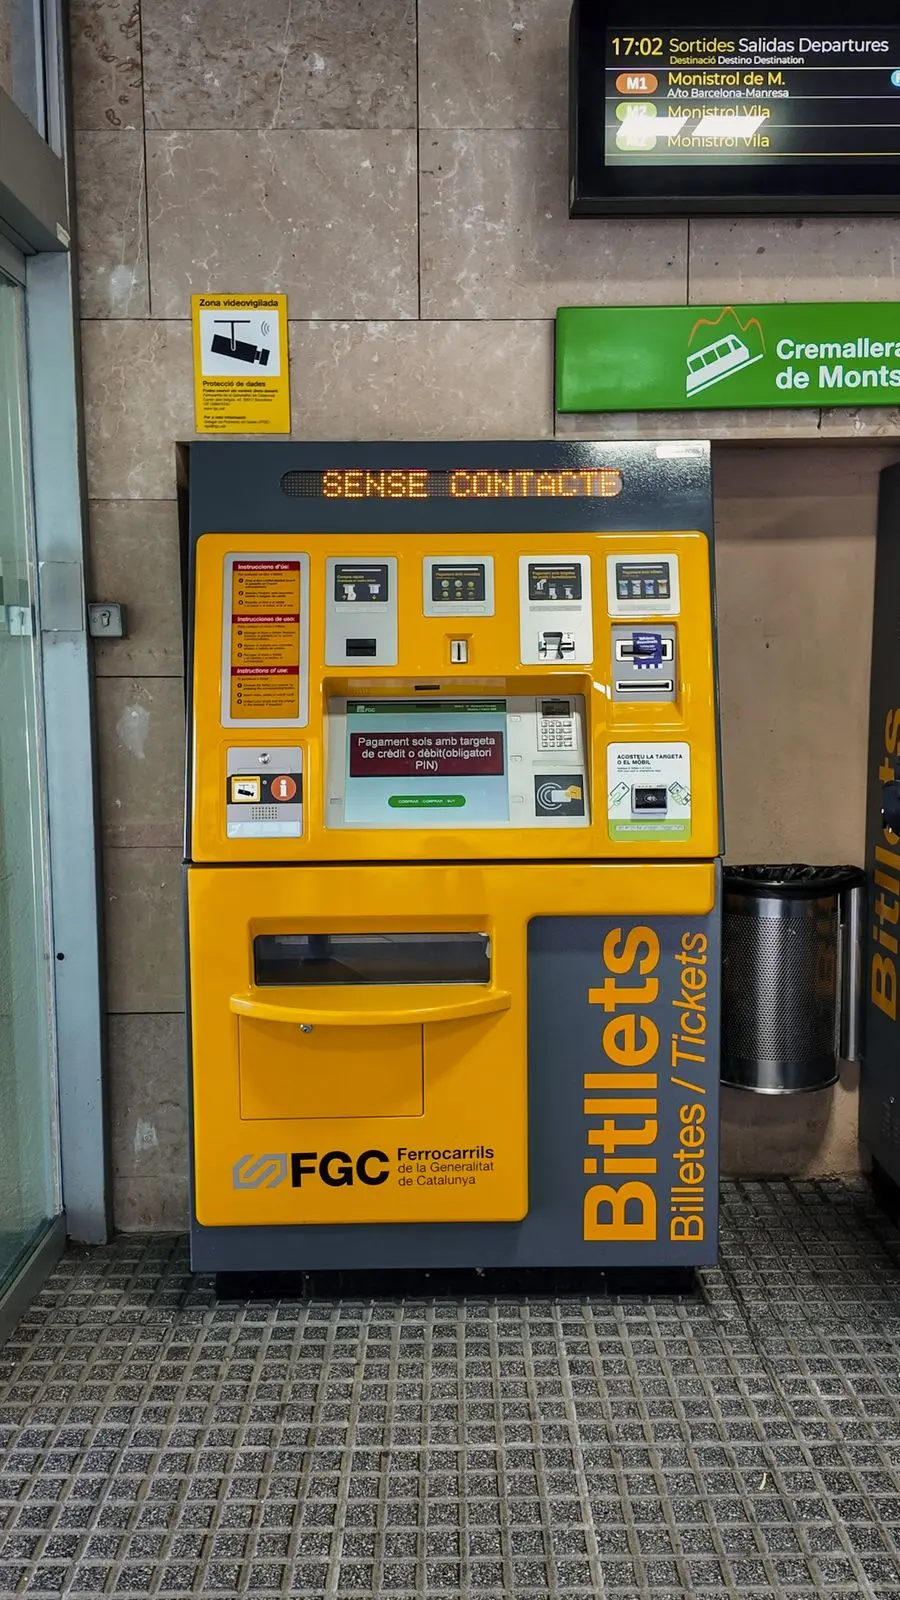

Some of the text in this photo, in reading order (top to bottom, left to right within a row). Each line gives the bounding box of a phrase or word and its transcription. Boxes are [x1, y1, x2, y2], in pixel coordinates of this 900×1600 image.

[612, 37, 890, 56] 17:02 Sortides Salidas Departures
[670, 56, 804, 64] Destinació Destino Destination
[626, 72, 786, 90] M1 Monistrol de M.
[667, 88, 790, 98] A/to Barcelona-Manresa
[668, 105, 738, 118] Monistrol
[200, 298, 278, 308] Zona videovigilada
[202, 380, 266, 388] Protecció de dades
[776, 366, 810, 389] de
[322, 472, 620, 498] SENSE CONTACTE
[358, 736, 496, 748] Pagament sols amb targeta
[362, 750, 374, 758] de
[377, 750, 406, 758] crèdit
[415, 760, 438, 772] PIN)
[583, 926, 660, 1241] Bitllets
[670, 931, 708, 1240] Billetes / Tickets
[397, 1146, 494, 1160] Ferrocarrils
[291, 1149, 390, 1188] FGC
[398, 1161, 495, 1174] de la Generalitat
[398, 1174, 476, 1188] de Catalunya
